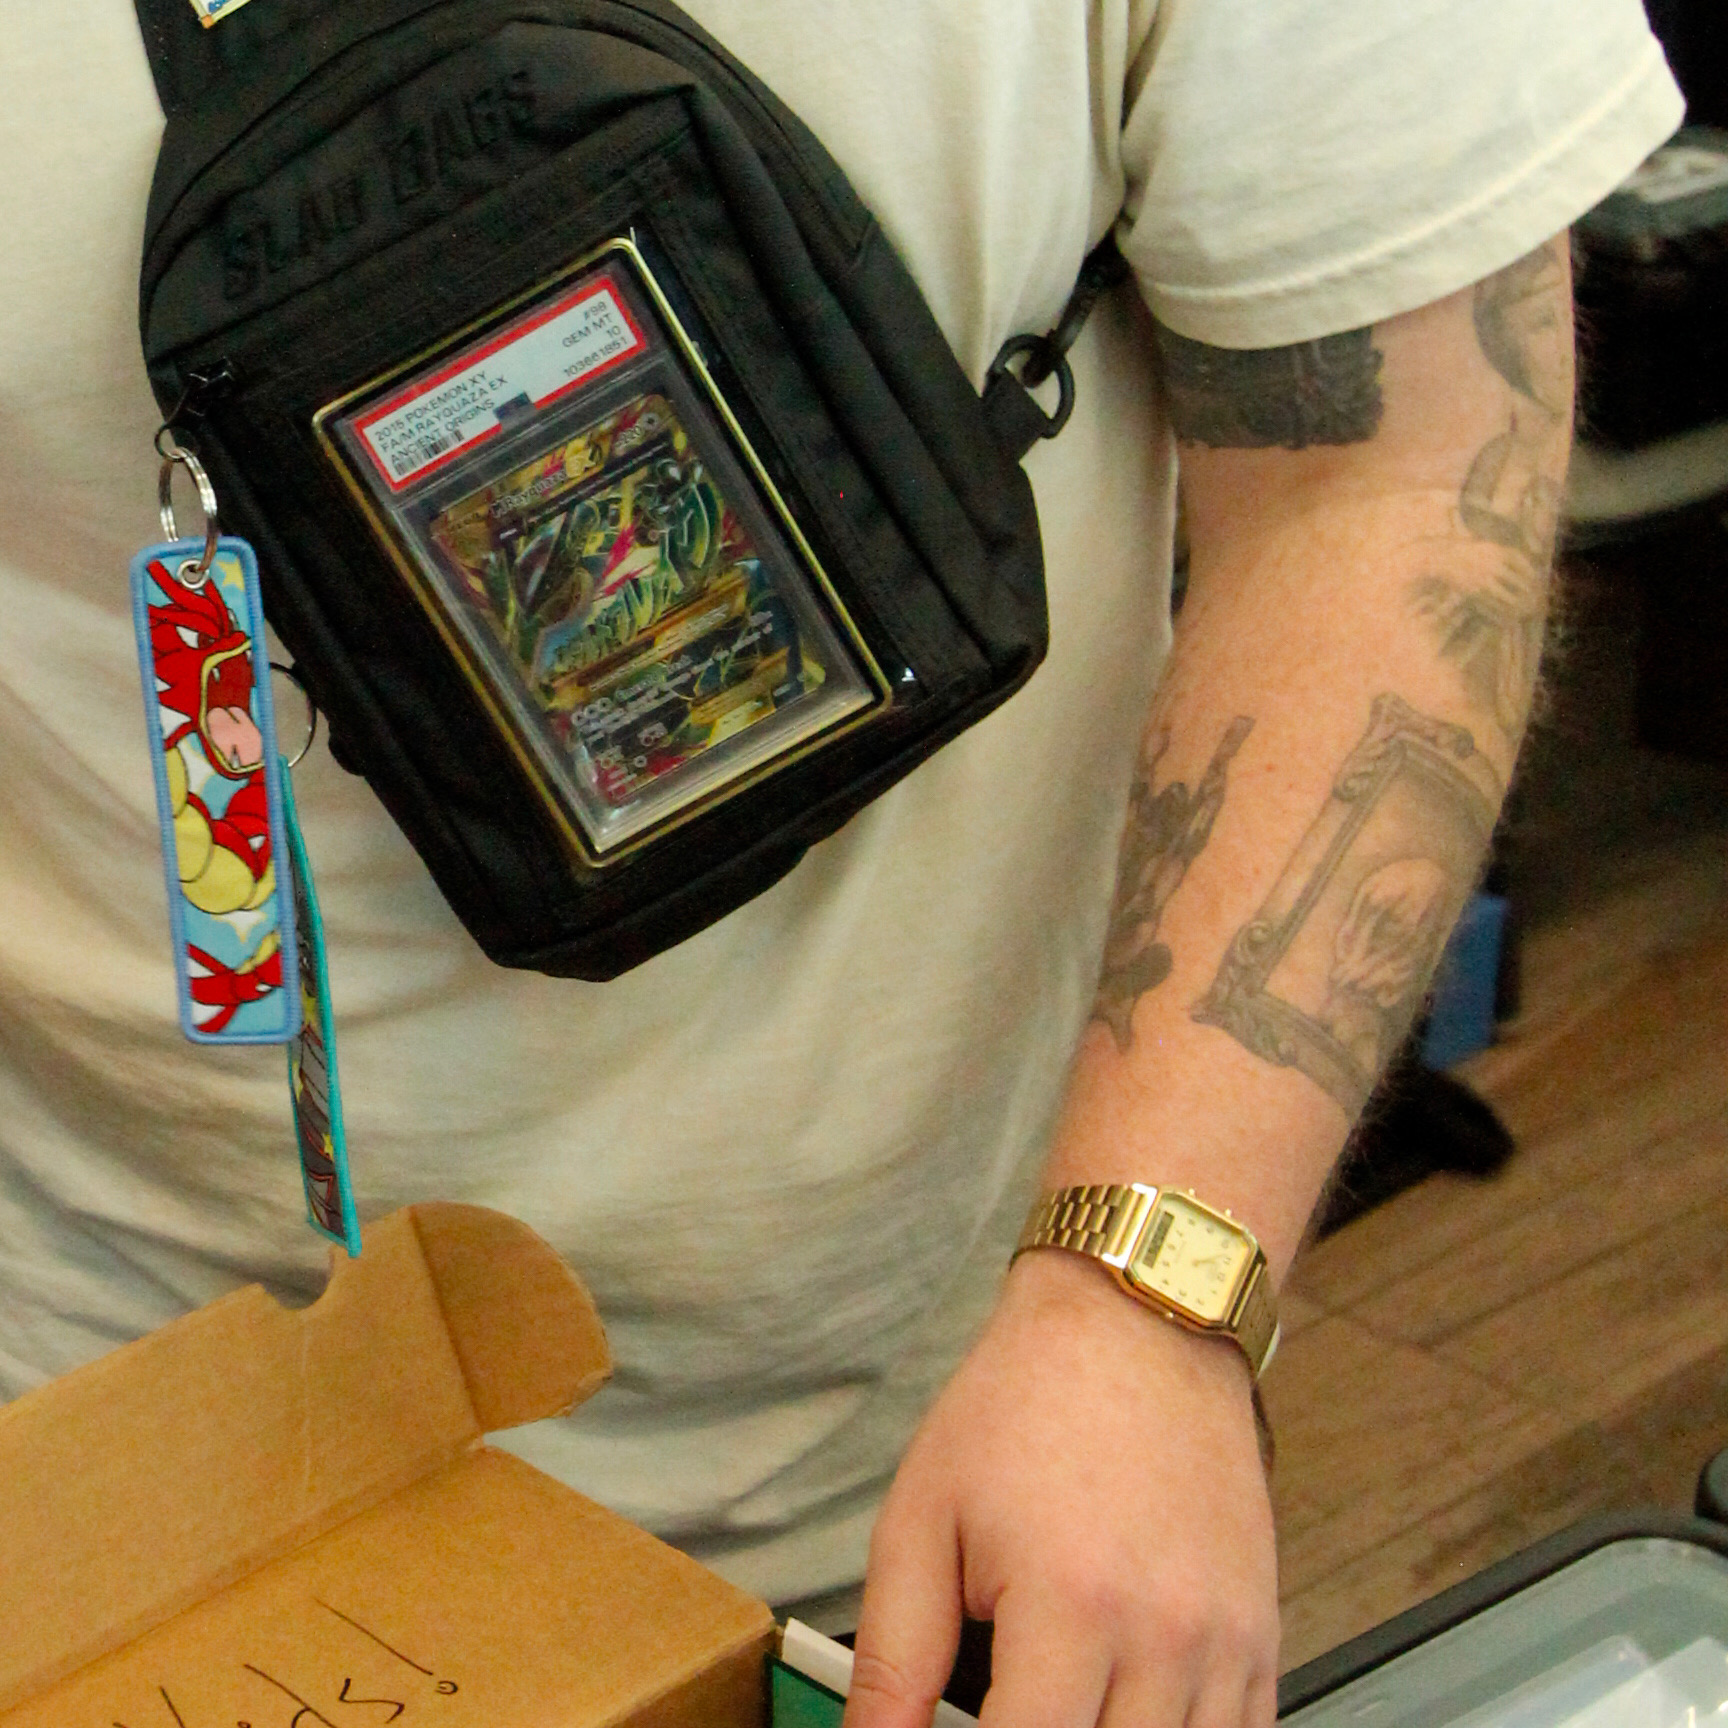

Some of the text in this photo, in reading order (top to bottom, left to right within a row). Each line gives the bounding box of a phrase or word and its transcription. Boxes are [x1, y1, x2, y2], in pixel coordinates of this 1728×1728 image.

[562, 312, 613, 349] GEM MT
[608, 325, 621, 339] 10
[374, 370, 488, 442] 2015 POKEMON XY
[381, 374, 508, 453] FA/M RAYQUAZA EX
[390, 398, 496, 465] ANCIENT ORIGINS
